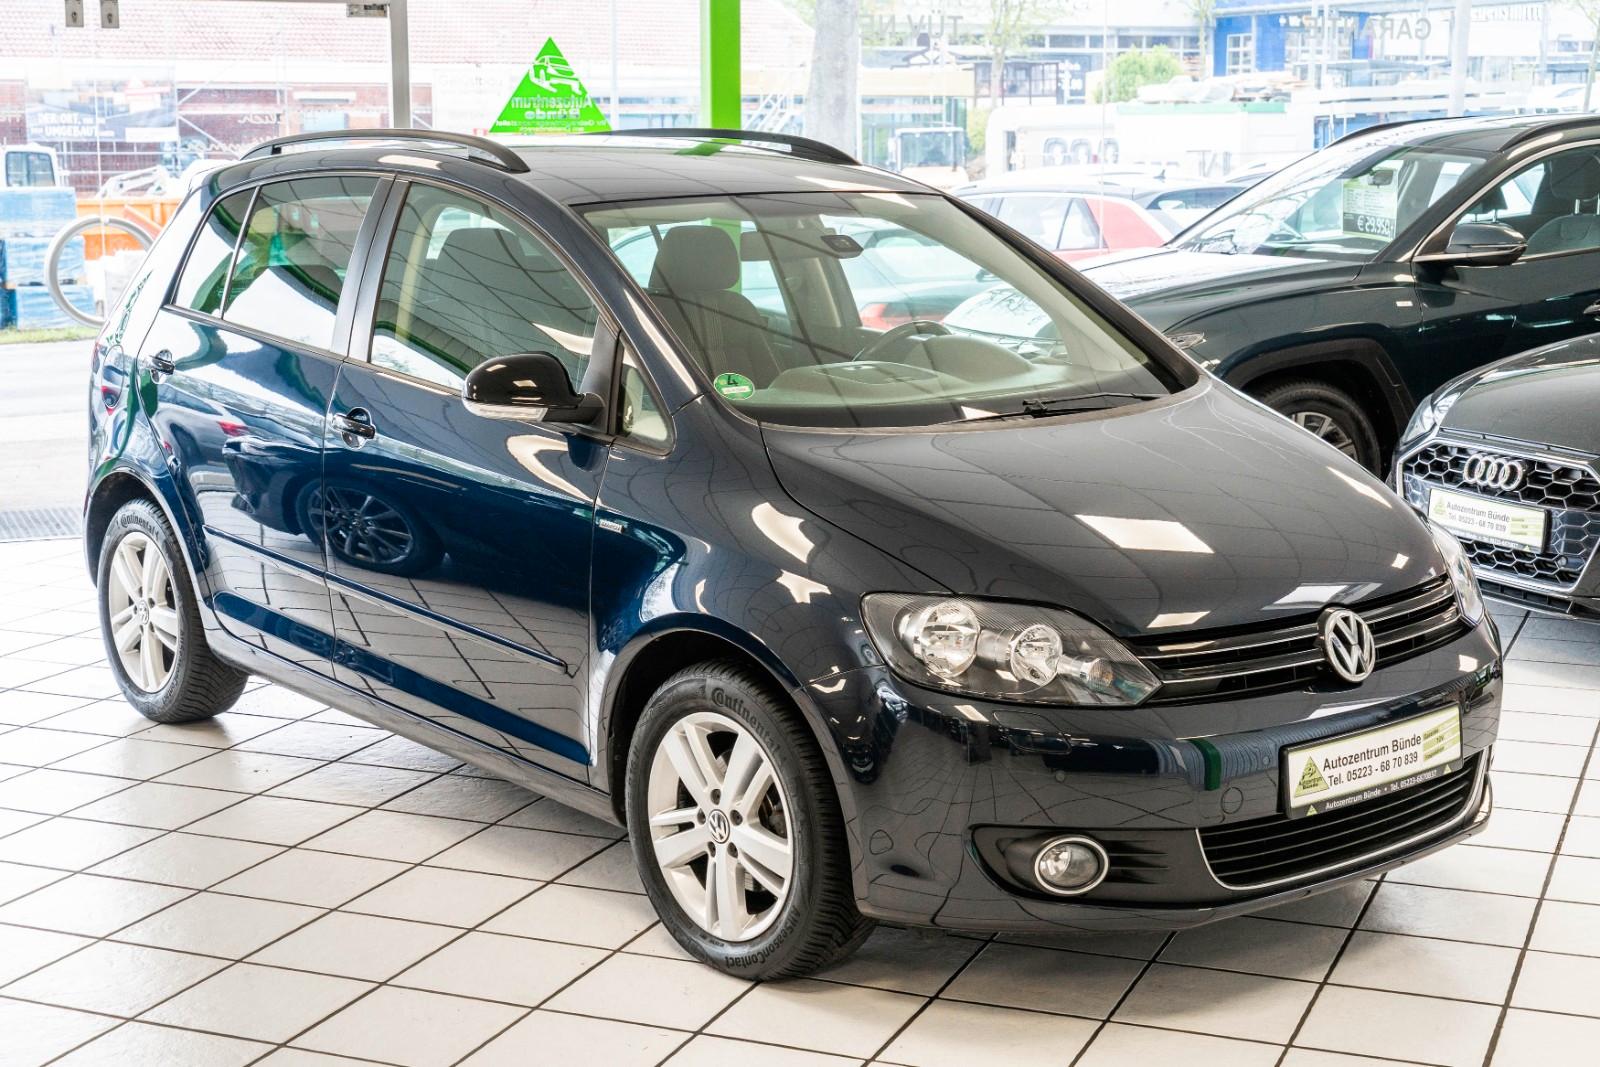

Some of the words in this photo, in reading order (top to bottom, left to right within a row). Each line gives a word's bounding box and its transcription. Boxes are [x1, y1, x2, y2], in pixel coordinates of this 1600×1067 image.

[727, 375, 738, 386] 4
[121, 512, 155, 536] Continental
[1447, 502, 1486, 517] Autozentrum
[1488, 511, 1510, 522] Bünde
[711, 687, 781, 757] Continental
[1323, 745, 1389, 771] Autozentrum
[1392, 733, 1421, 753] Bünde
[1328, 773, 1344, 787] Tel.
[1347, 765, 1373, 782] 05223
[1380, 760, 1390, 772] 68
[1393, 756, 1402, 768] 70
[1404, 751, 1418, 766] 839
[1325, 794, 1362, 810] Autozentrum
[1363, 788, 1381, 799] Bünde
[725, 905, 801, 968] AllSeasonContact
